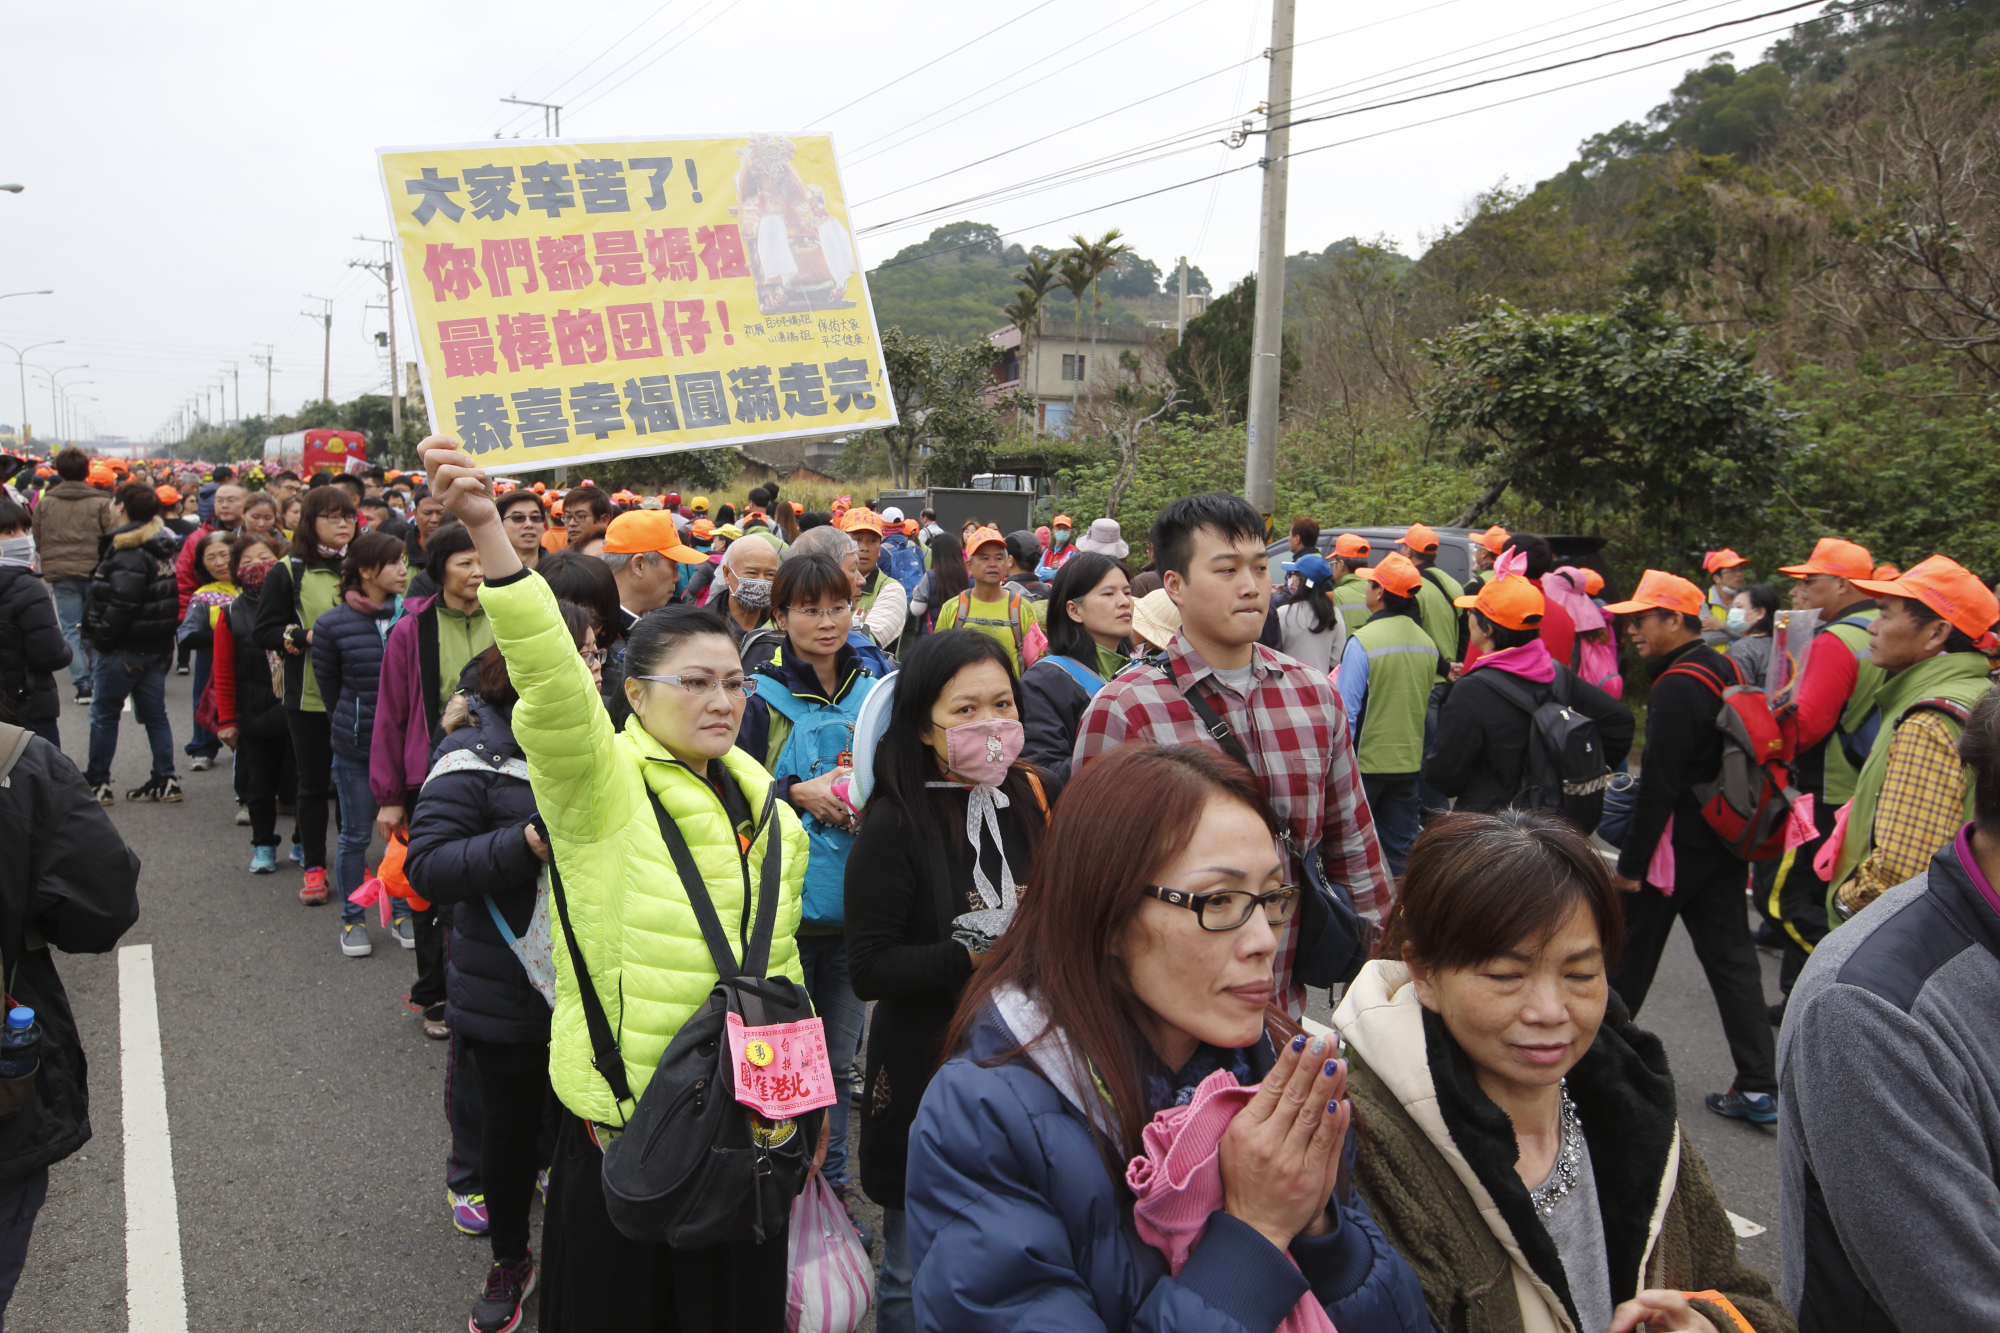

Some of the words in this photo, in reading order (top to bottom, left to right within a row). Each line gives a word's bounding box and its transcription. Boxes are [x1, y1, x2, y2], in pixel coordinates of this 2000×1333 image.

[405, 157, 703, 226] 大家辛苦了!
[423, 224, 751, 302] 你們都是媽祖
[437, 300, 735, 379] 最棒的囝仔!
[817, 318, 860, 333] 保佑大家
